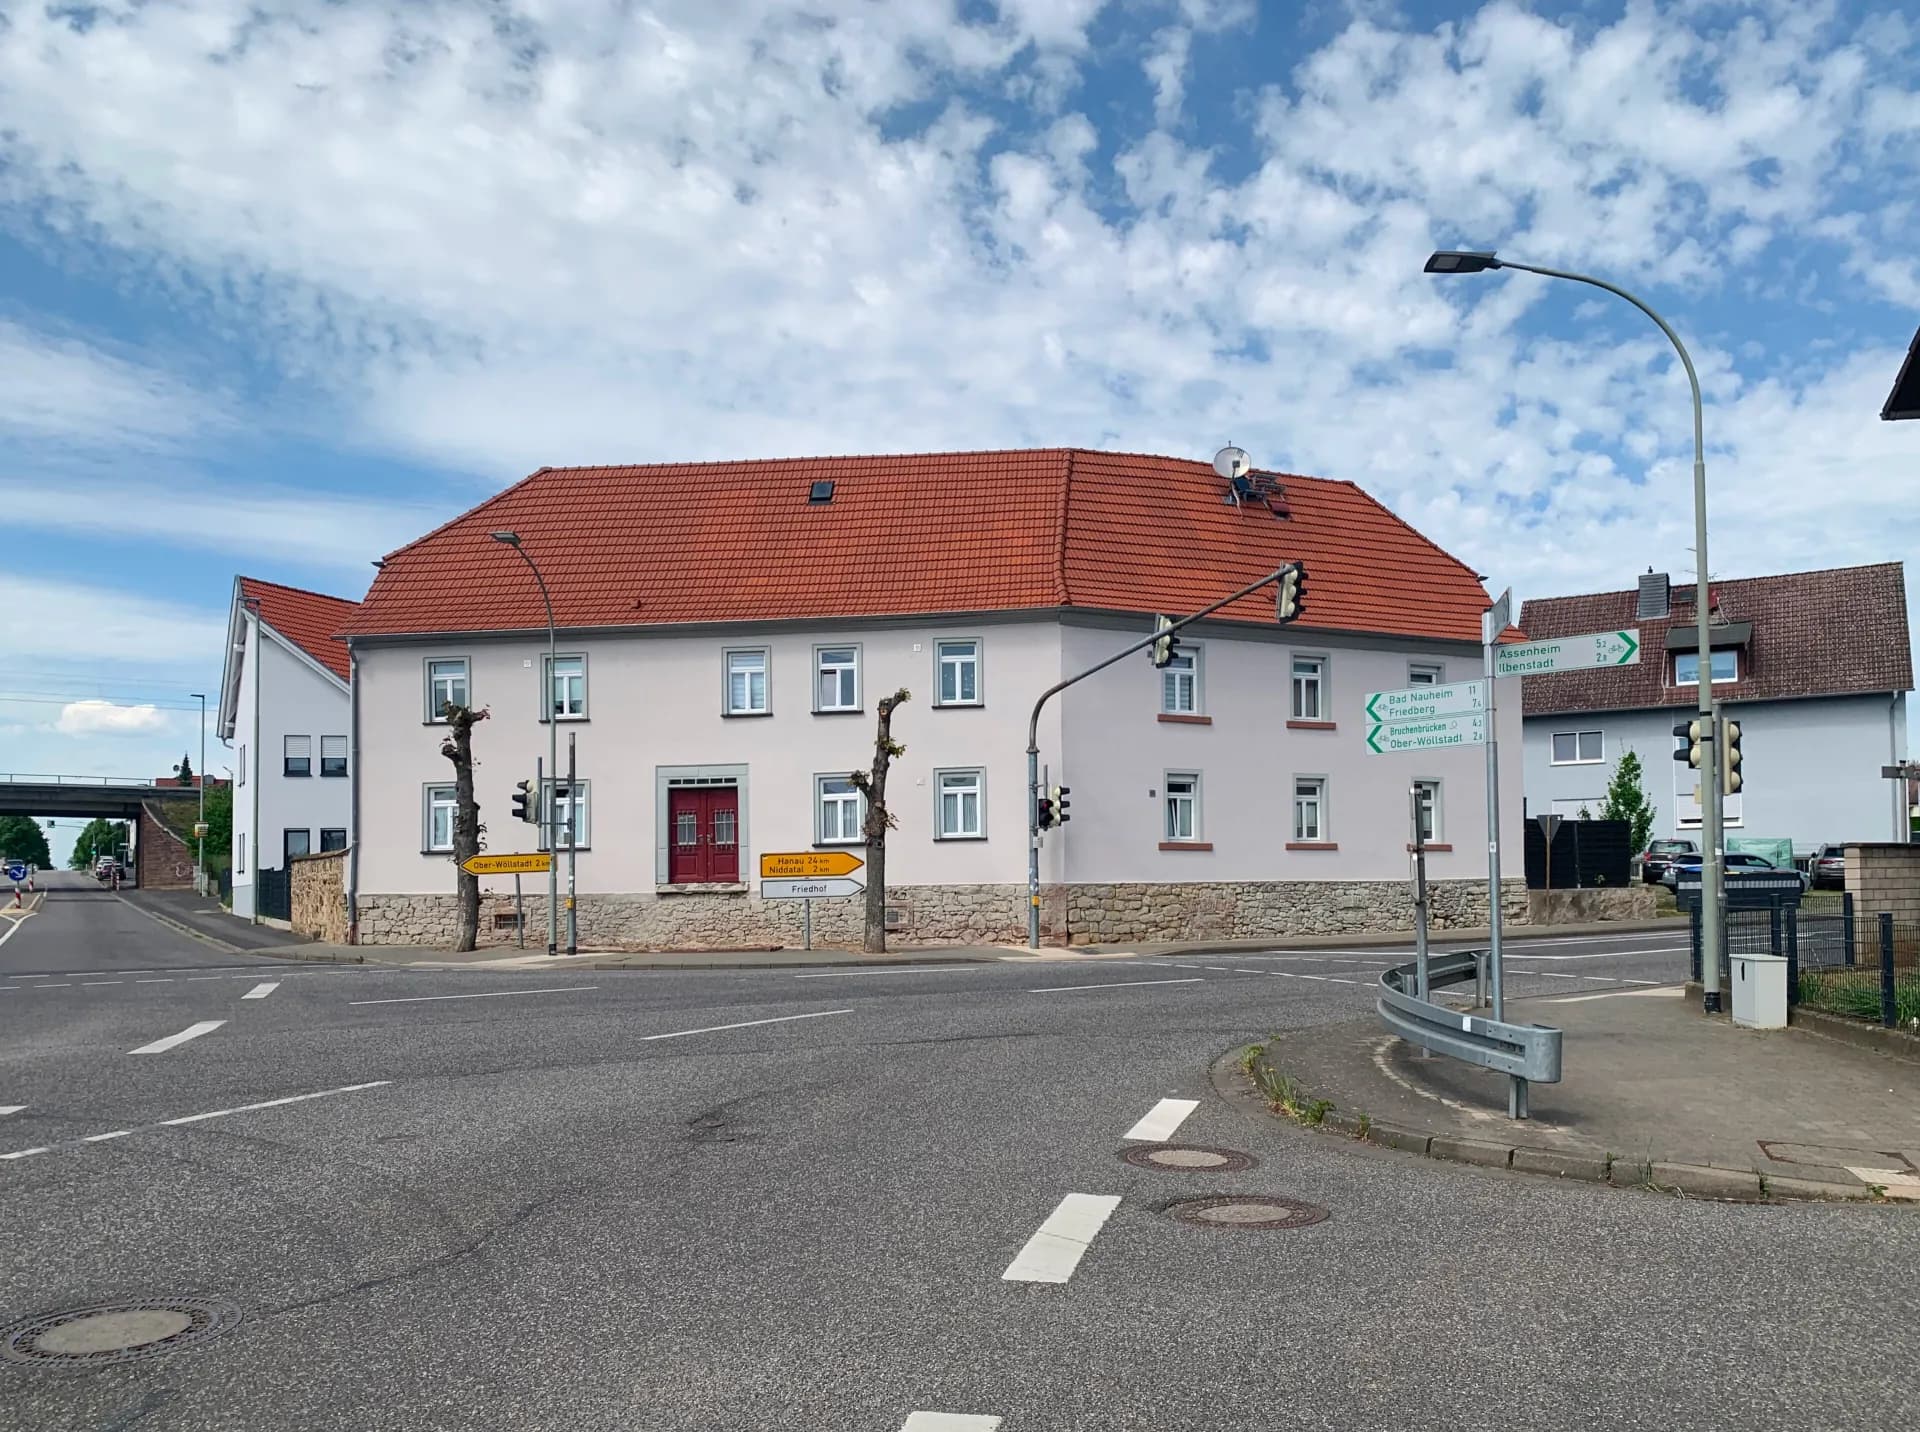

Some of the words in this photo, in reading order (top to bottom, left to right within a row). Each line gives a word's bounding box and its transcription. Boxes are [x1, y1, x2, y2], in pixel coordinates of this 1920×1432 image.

[1499, 645, 1561, 659] Assenheim
[1499, 659, 1554, 673] Ilbenstadt
[1389, 695, 1407, 704] Bad
[1410, 689, 1453, 701] Nauheim
[1468, 685, 1476, 695] 11
[1389, 705, 1435, 717] Friedberg
[1390, 723, 1447, 736] Bruchenbrücken
[1390, 734, 1463, 749] Ober-Wöllstadt
[473, 860, 532, 869] Ober-Wöllstadt
[778, 857, 805, 865] Hanau
[807, 857, 818, 865] 24
[769, 866, 804, 874] Niddatal
[791, 885, 827, 893] Friedhof
